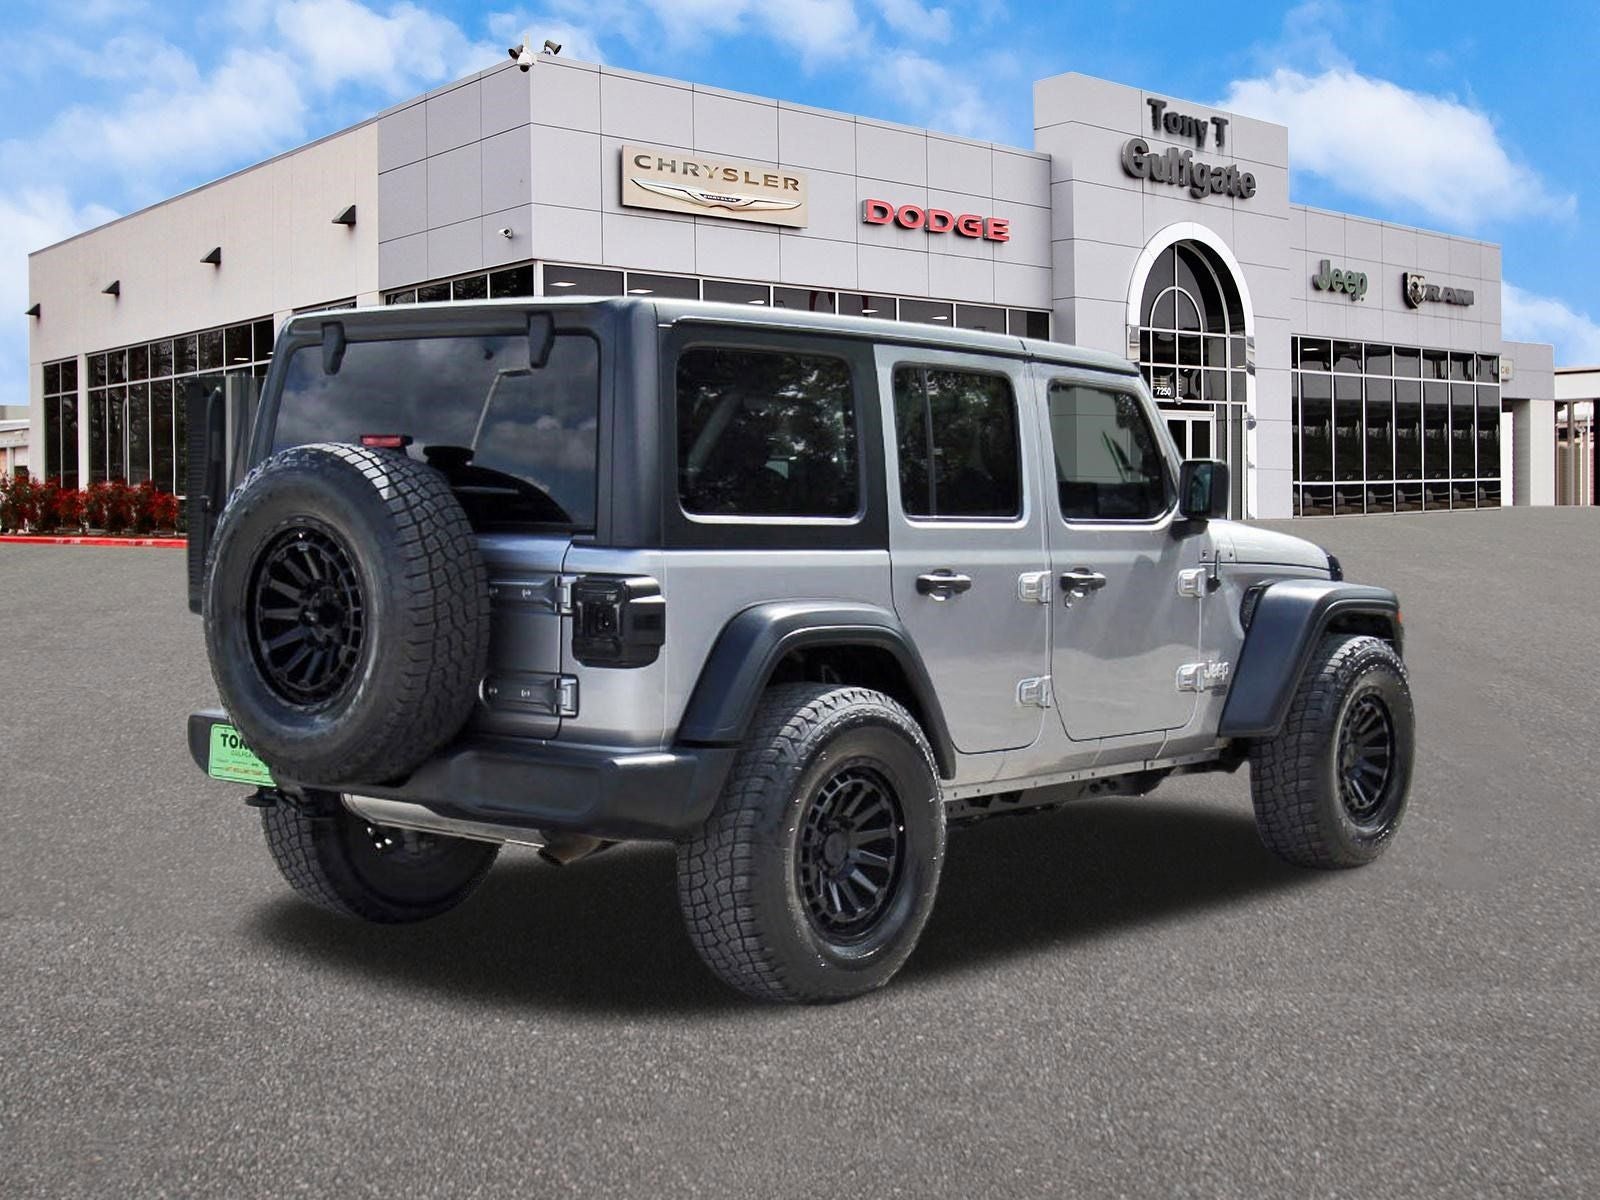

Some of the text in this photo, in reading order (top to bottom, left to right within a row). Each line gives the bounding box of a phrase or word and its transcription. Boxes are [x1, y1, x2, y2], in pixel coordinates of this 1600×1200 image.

[1147, 98, 1229, 147] Tony T
[634, 154, 800, 192] CHRYSLER
[1121, 138, 1256, 199] Gulfgate
[863, 199, 1010, 242] DODGE
[1312, 260, 1368, 302] Jeep
[1425, 284, 1475, 307] RAM
[1203, 659, 1229, 681] Jeep
